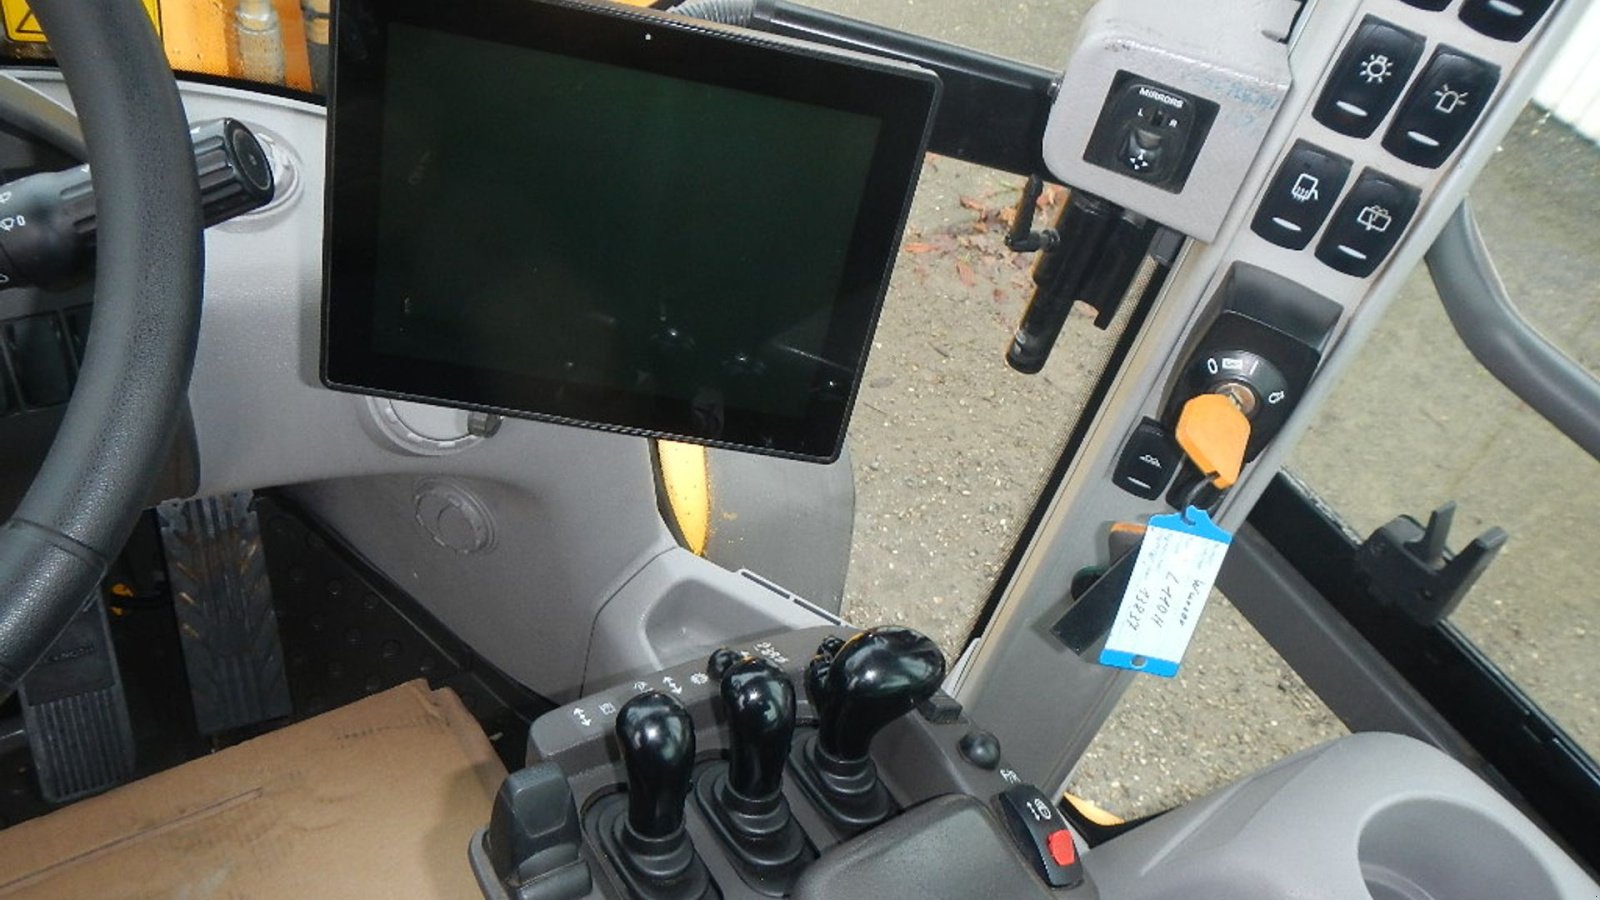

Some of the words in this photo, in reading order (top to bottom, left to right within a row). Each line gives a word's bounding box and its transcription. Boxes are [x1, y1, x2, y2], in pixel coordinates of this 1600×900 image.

[1139, 87, 1184, 109] MIRRORS
[1137, 108, 1143, 117] L
[1169, 118, 1178, 128] R
